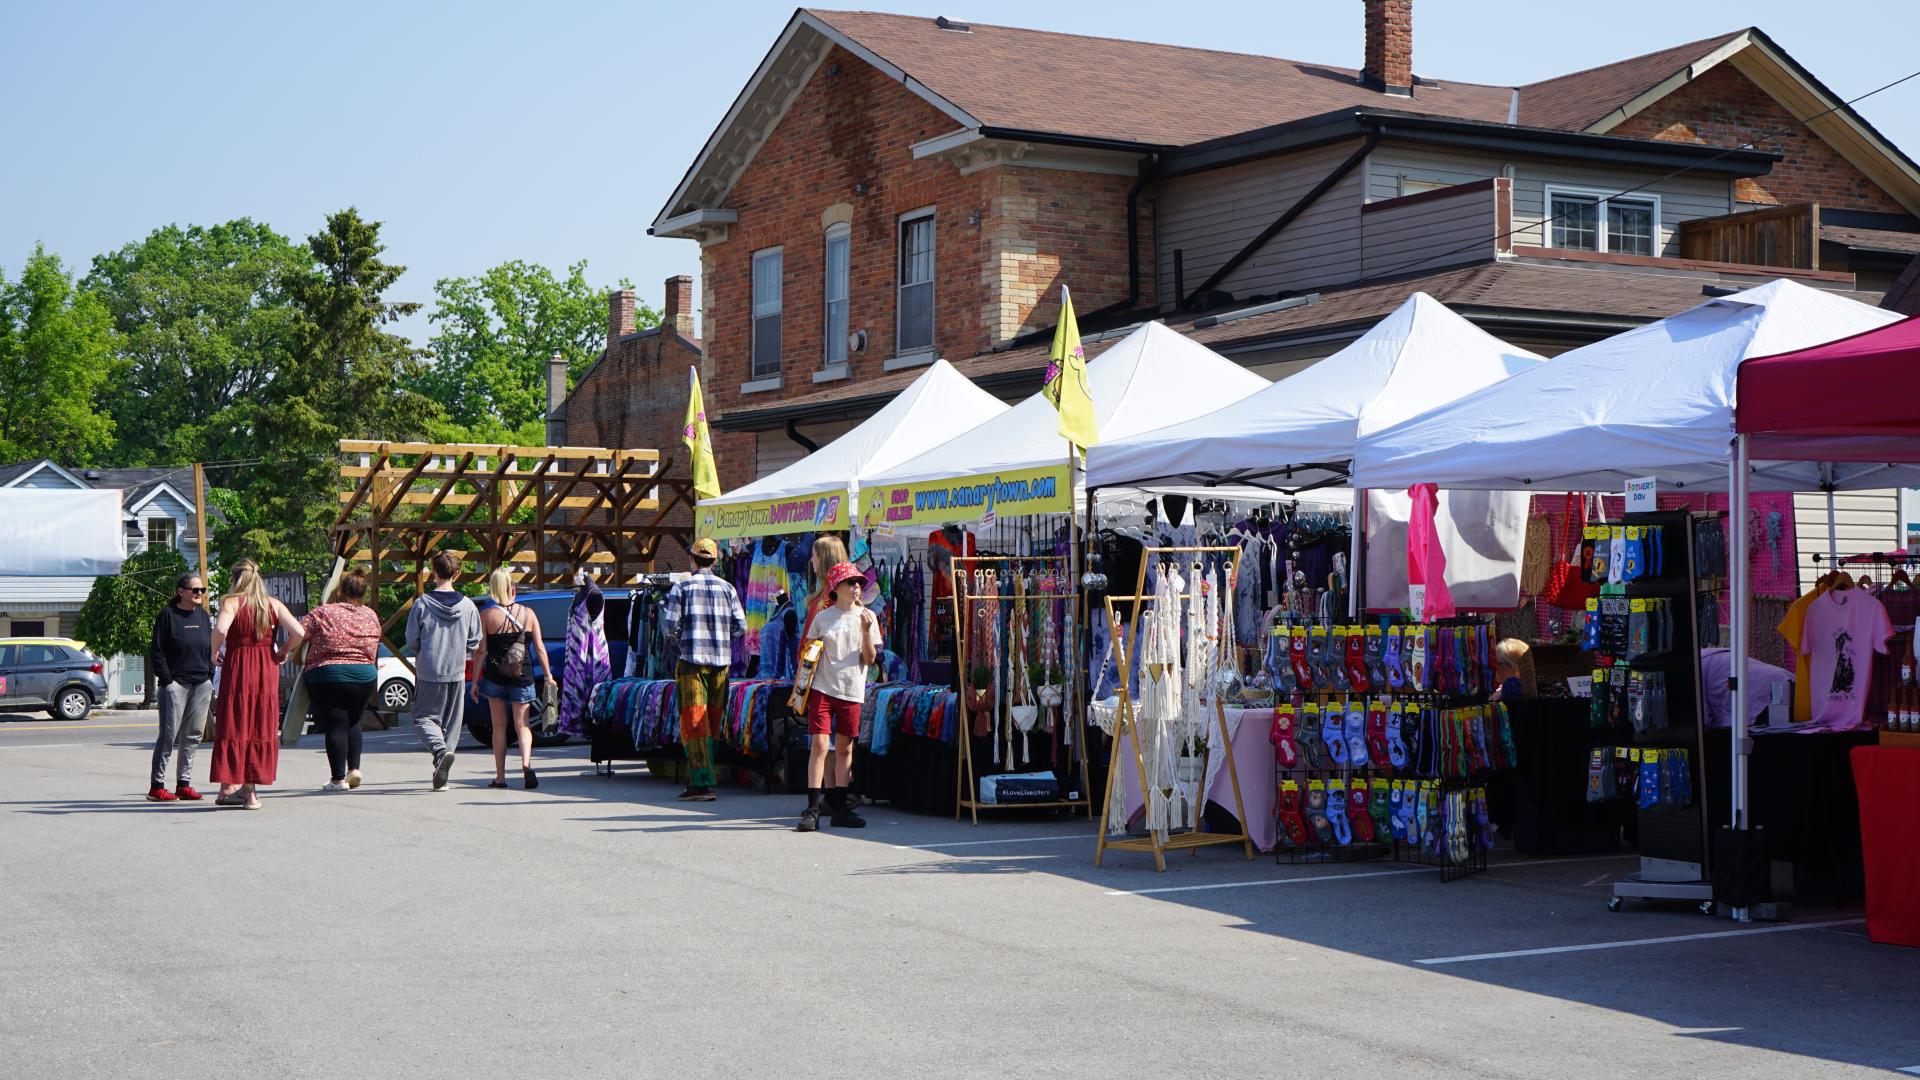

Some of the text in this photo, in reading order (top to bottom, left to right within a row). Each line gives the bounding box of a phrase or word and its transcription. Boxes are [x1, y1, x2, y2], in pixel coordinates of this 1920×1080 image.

[890, 488, 910, 504] SHOP
[914, 476, 1056, 513] www.canarytown.com
[886, 504, 914, 521] ONLINE
[264, 576, 306, 604] MERCIAL
